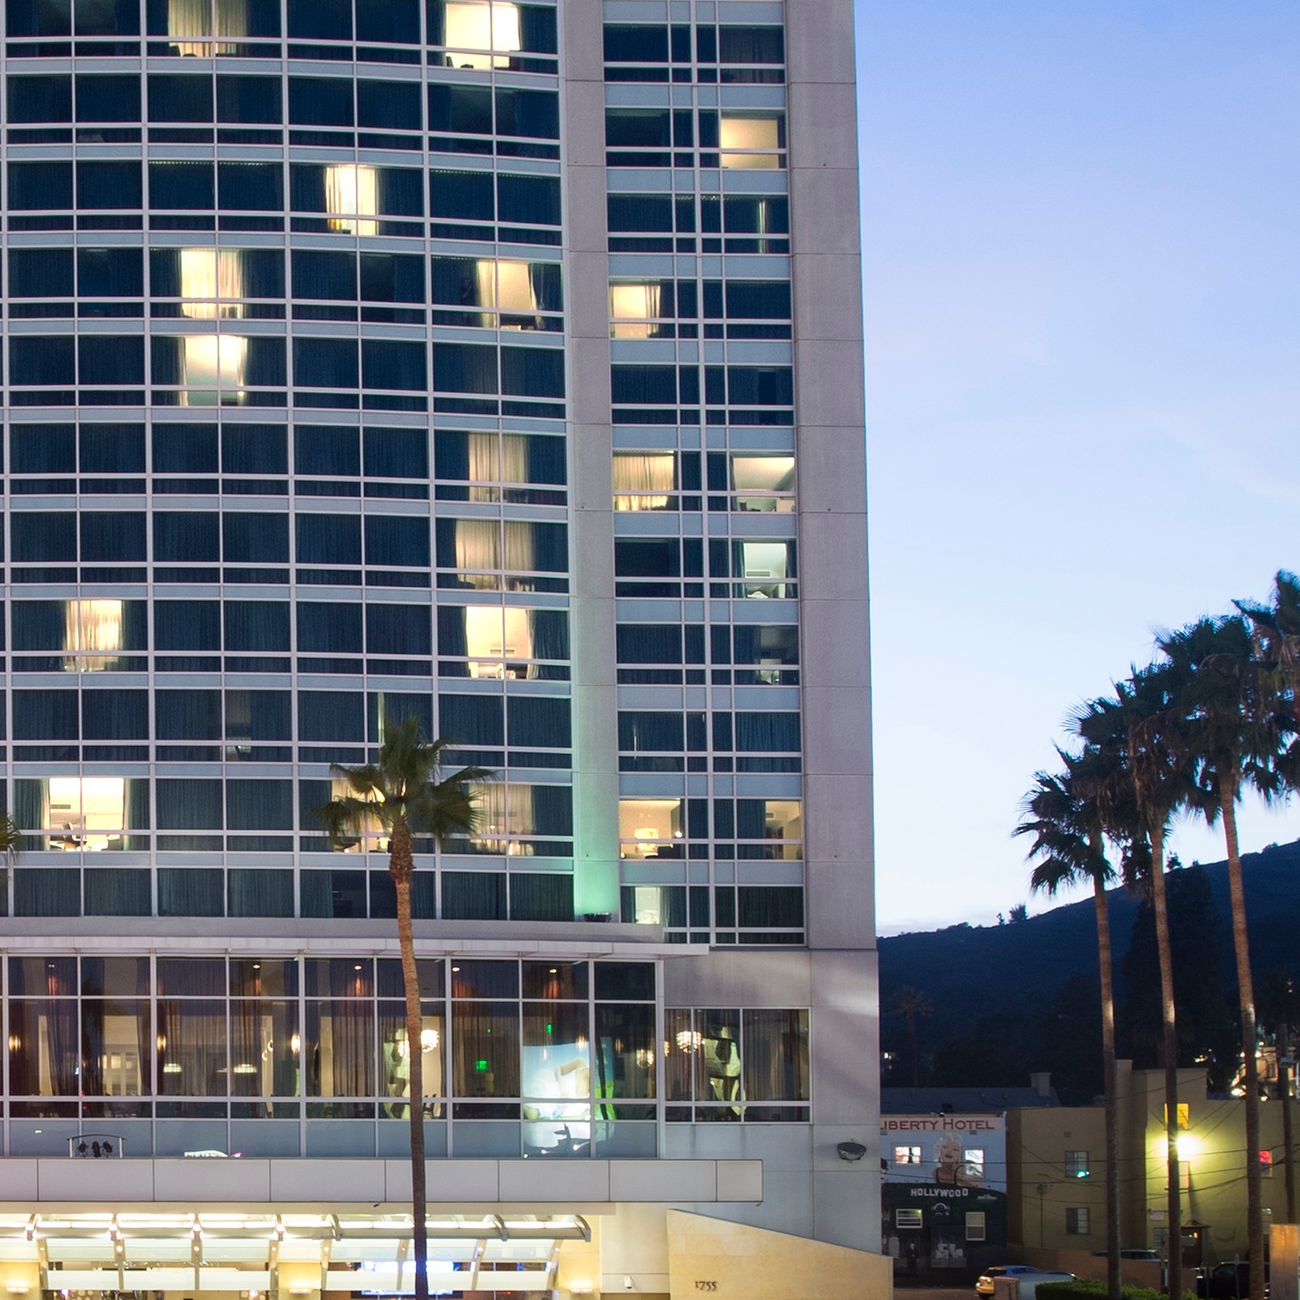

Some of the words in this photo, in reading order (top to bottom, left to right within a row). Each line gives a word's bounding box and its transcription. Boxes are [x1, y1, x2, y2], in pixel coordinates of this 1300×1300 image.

[943, 1118, 995, 1130] HOTEL
[910, 1188, 969, 1197] HOLLYWOOD
[695, 1280, 717, 1291] 1755
